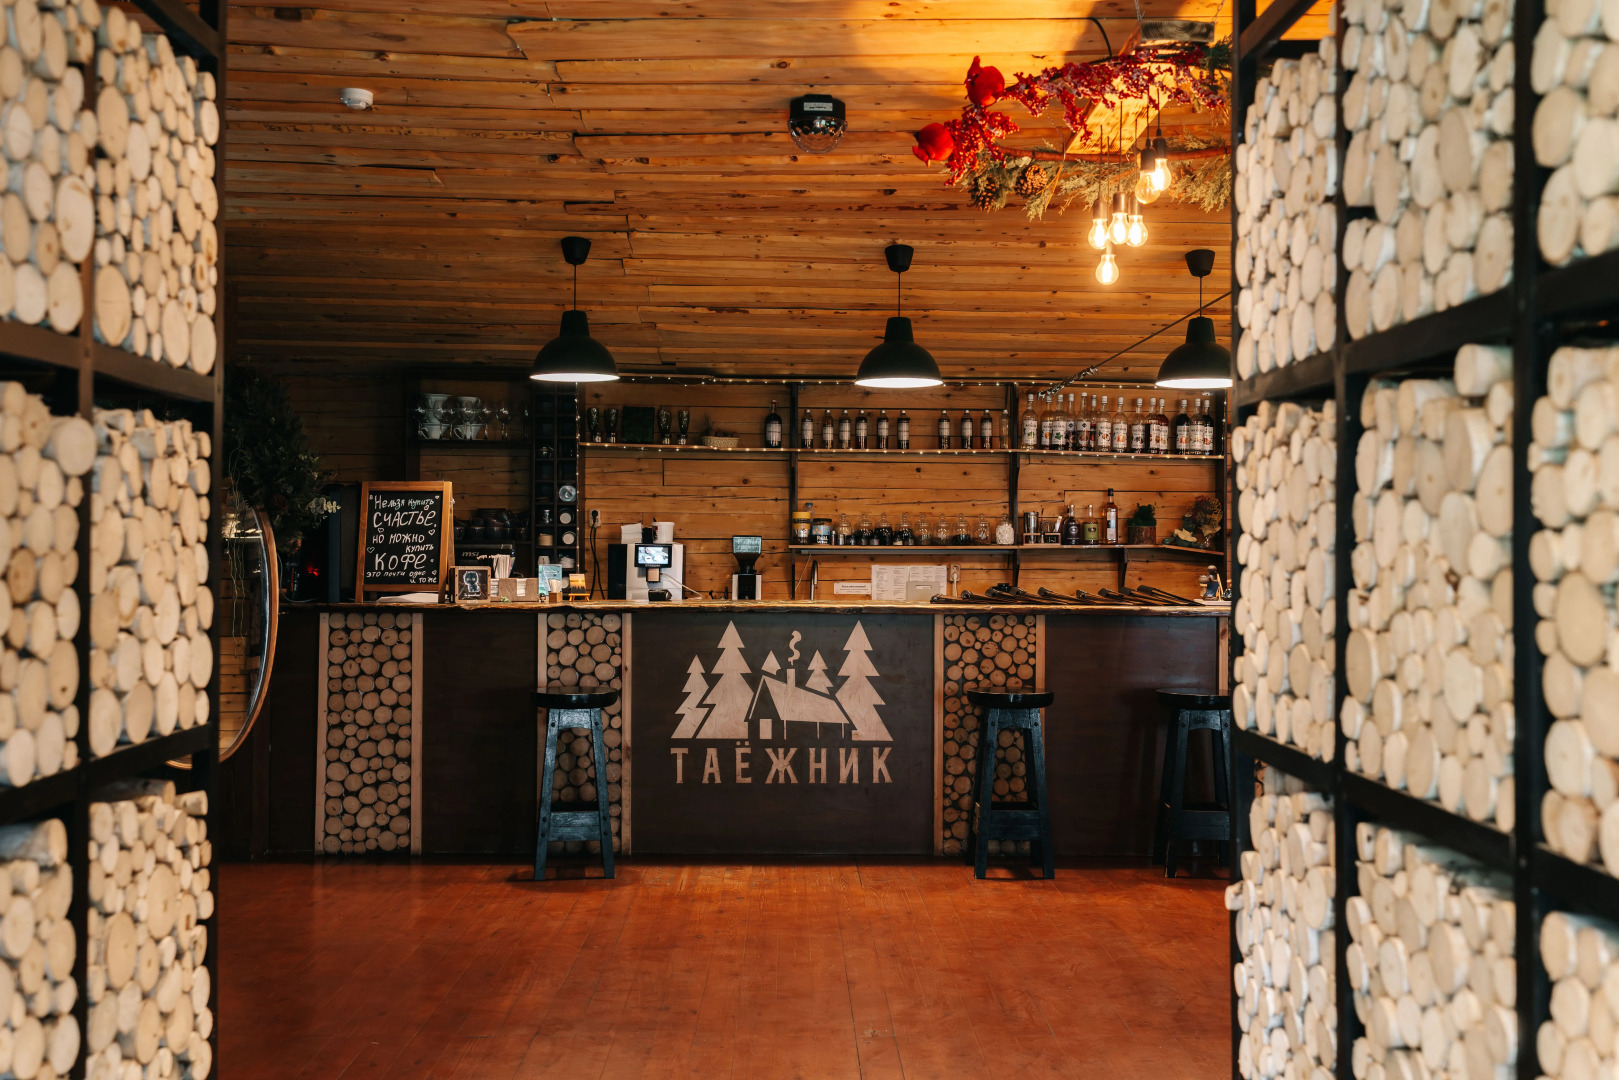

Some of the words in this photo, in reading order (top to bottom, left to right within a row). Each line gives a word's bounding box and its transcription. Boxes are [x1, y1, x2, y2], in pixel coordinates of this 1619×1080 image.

[374, 495, 405, 510] Нельзя
[408, 498, 434, 509] купить
[670, 741, 893, 784] ТАЁЖНИК
